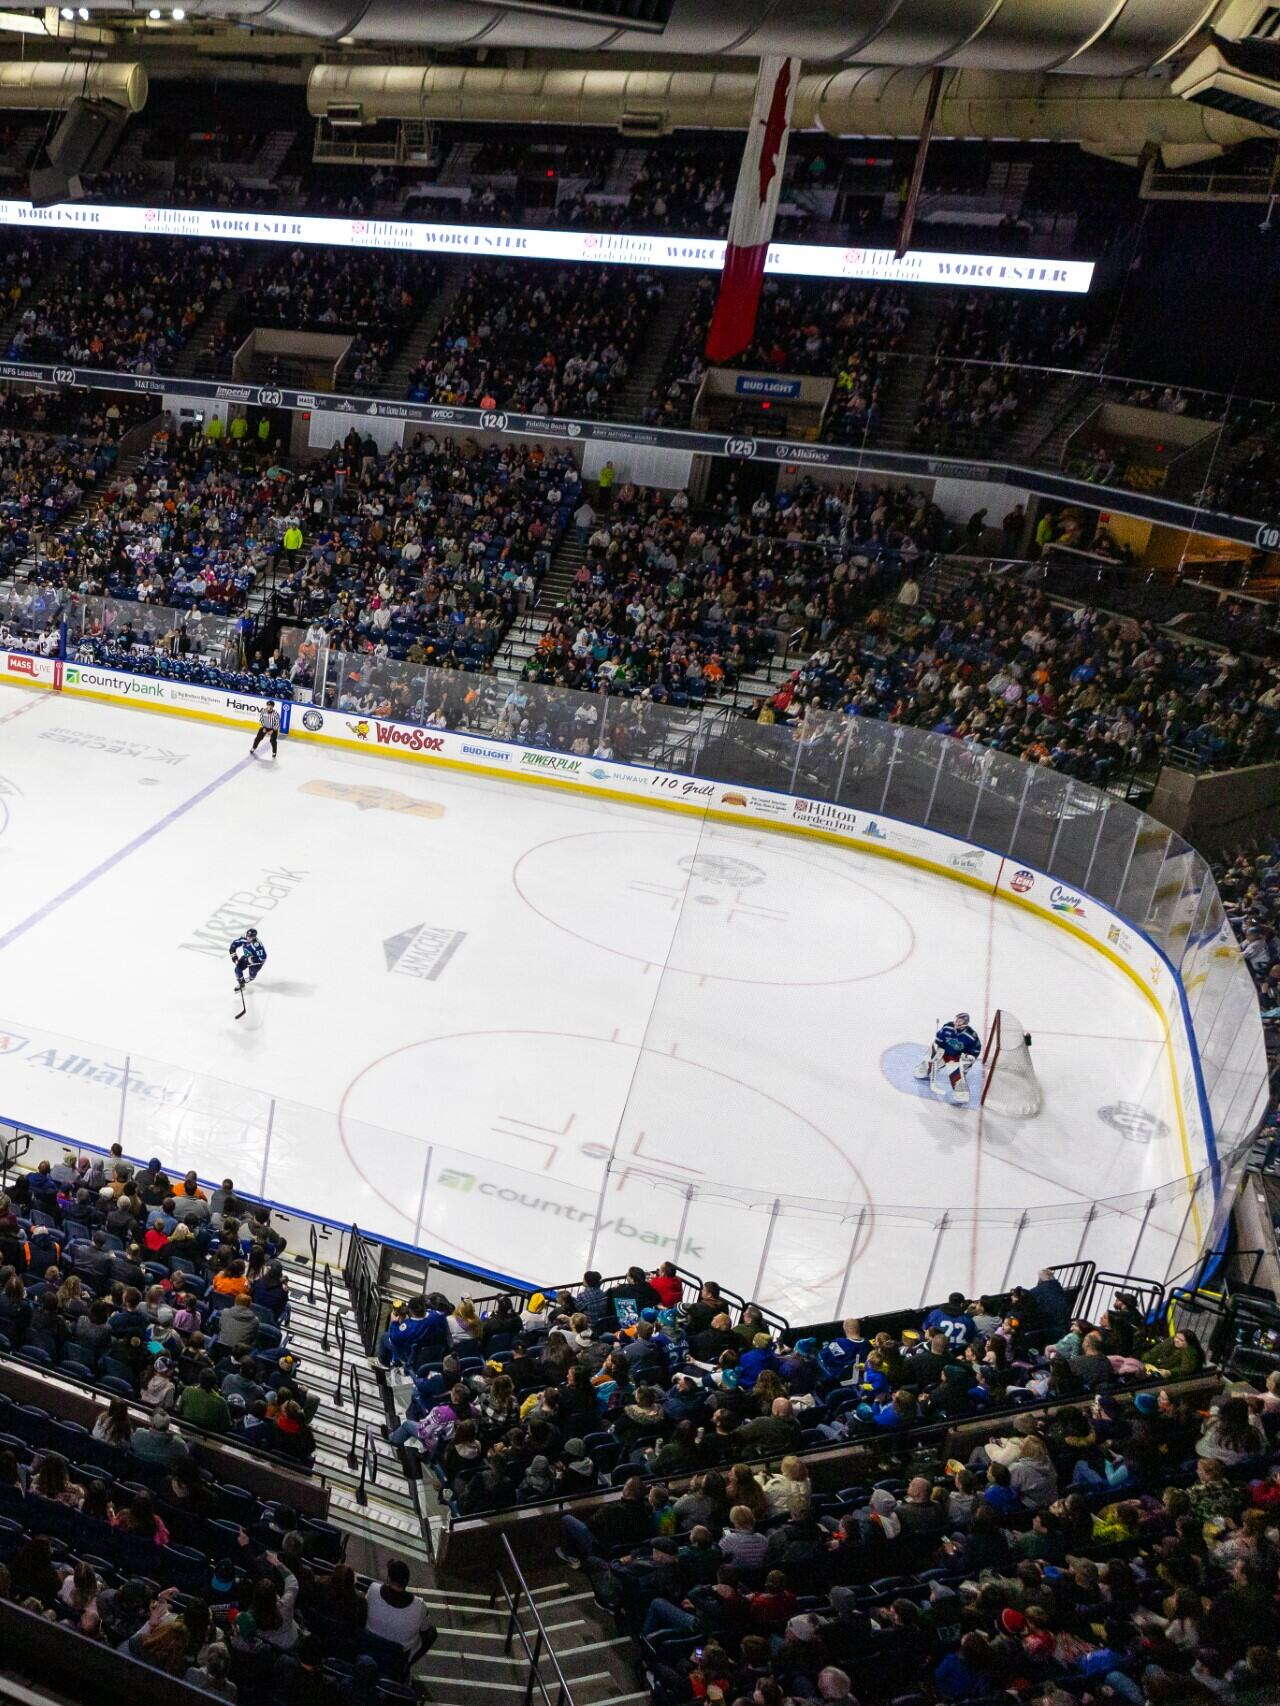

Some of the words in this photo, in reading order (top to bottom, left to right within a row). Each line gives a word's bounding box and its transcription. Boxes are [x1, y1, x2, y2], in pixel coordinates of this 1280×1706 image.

[55, 370, 73, 383] 122
[215, 386, 251, 398] Imperial
[742, 380, 763, 392] BUD
[763, 382, 794, 394] LIGHT
[260, 391, 280, 405] 123
[482, 413, 505, 429] 124
[730, 439, 753, 456] 125
[789, 447, 830, 461] Alliance
[9, 658, 32, 670] MASS
[80, 672, 164, 697] countrybank
[375, 721, 445, 752] WooSox
[462, 745, 483, 756] BUD
[483, 748, 511, 761] LIGHT
[613, 772, 649, 784] NUWAVE
[651, 776, 679, 789] 110
[681, 781, 716, 797] Grill
[792, 811, 833, 829] Garden
[808, 801, 857, 824] Hilton
[228, 866, 311, 911] Bank
[478, 1182, 706, 1259] countrybank
